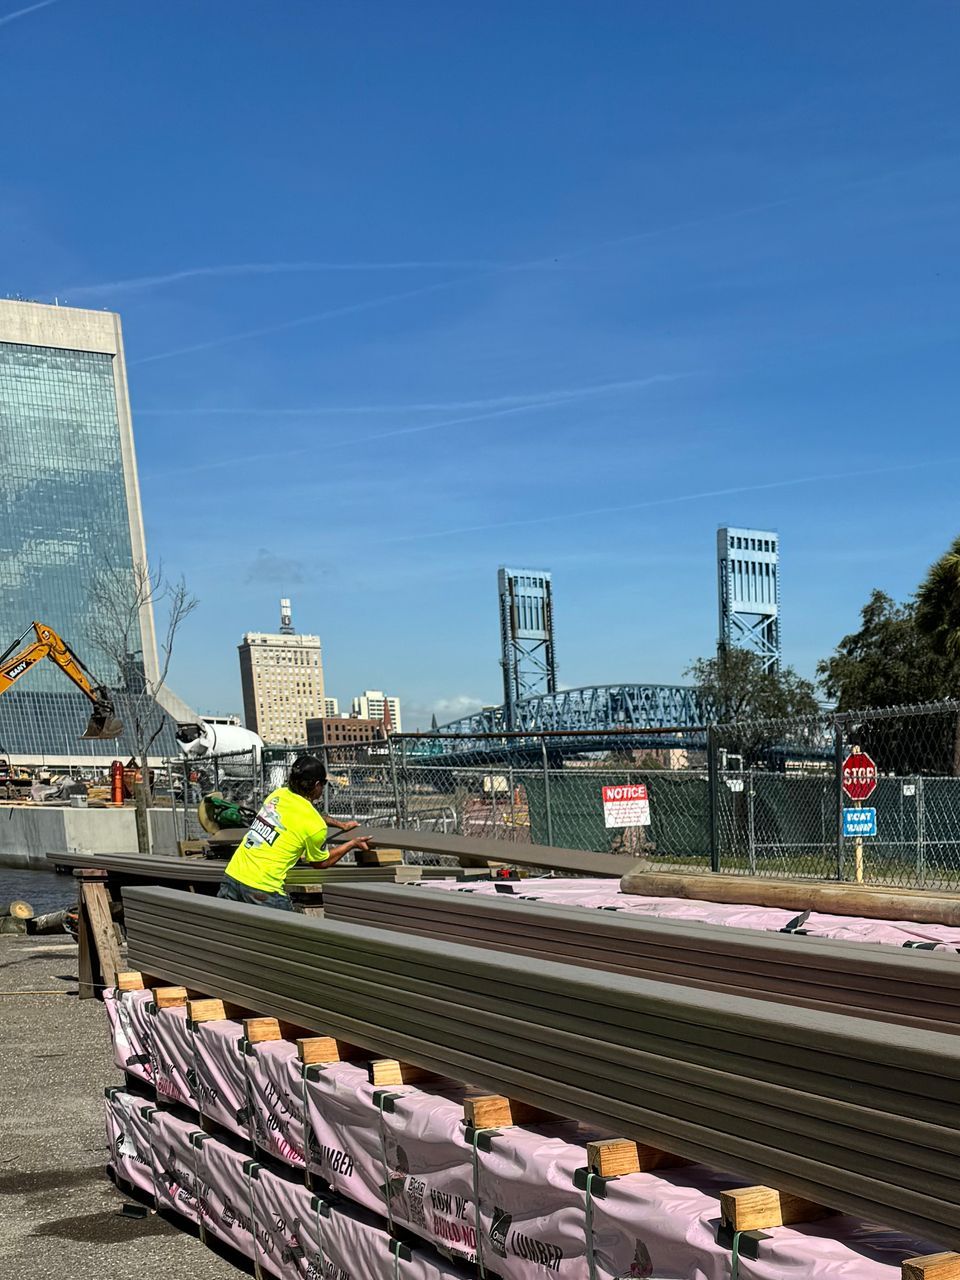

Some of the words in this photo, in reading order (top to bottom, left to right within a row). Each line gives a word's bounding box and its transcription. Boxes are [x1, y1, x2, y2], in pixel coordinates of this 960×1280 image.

[843, 767, 875, 785] STOP
[606, 787, 646, 799] NOTICE
[434, 1216, 461, 1242] BUILD
[461, 1224, 476, 1249] NO
[511, 1230, 563, 1272] LUMBER
